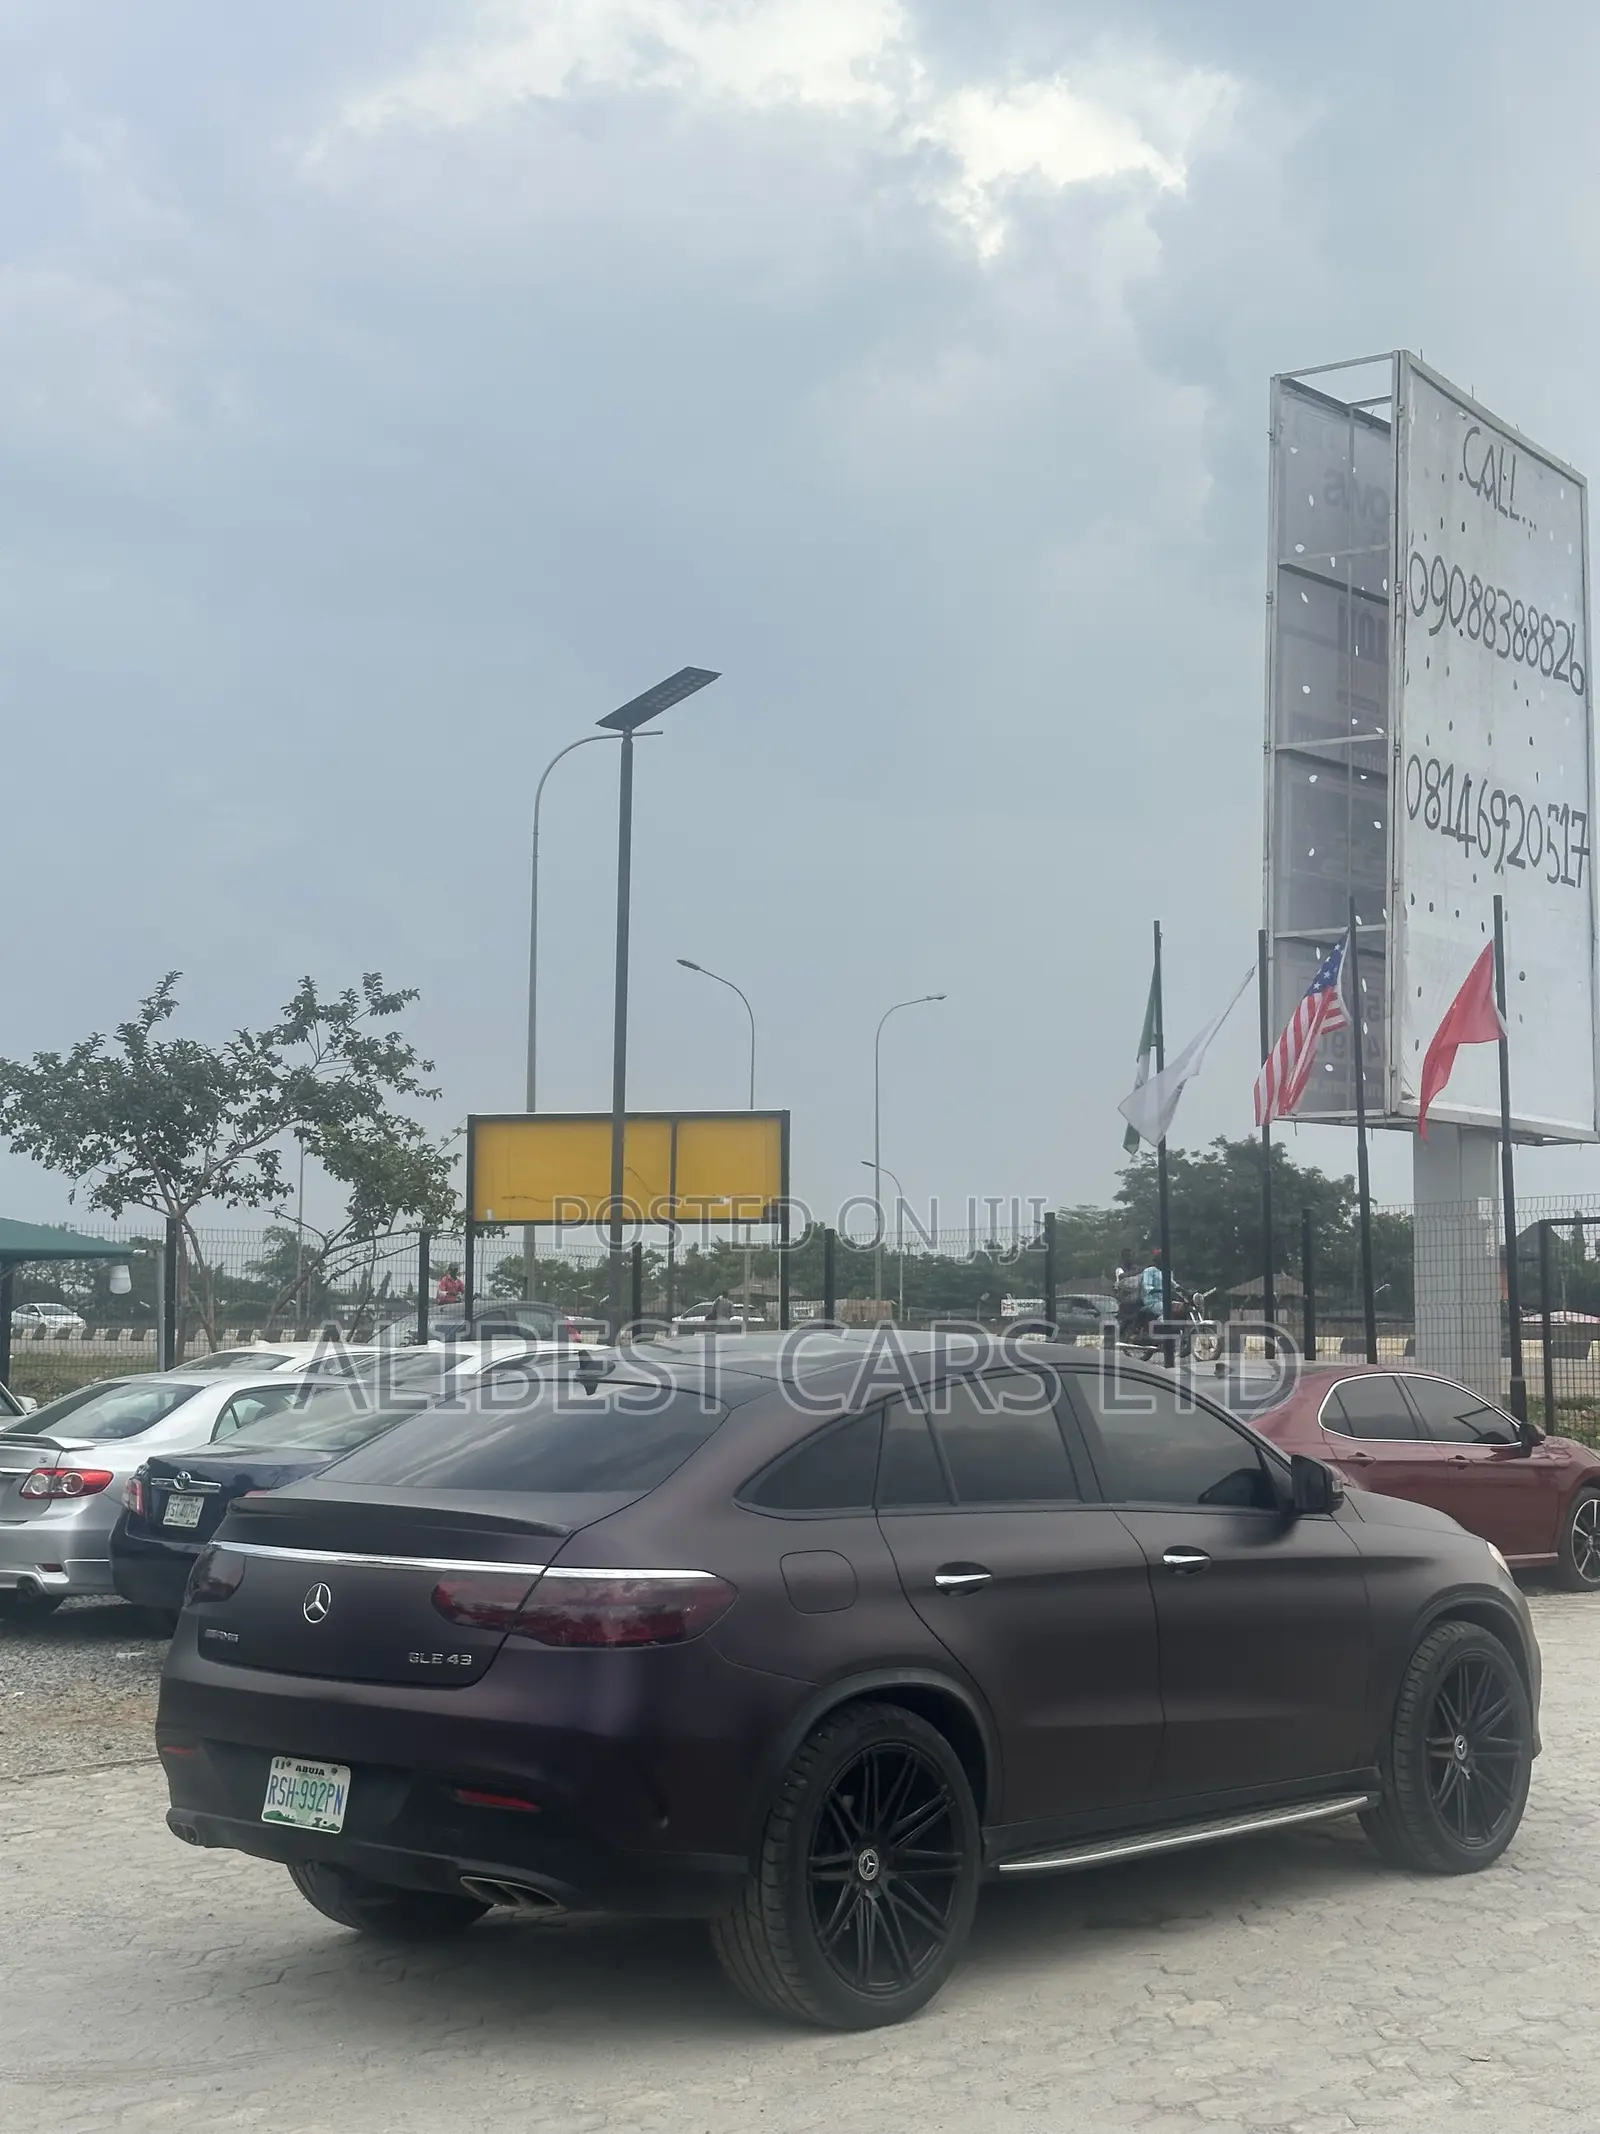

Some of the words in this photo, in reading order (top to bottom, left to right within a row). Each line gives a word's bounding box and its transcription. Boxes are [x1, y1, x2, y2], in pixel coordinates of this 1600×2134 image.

[1409, 551, 1585, 696] 09088388826
[1405, 754, 1590, 889] 08146920517
[408, 1652, 443, 1664] GLE
[447, 1654, 472, 1666] 43
[295, 1765, 325, 1776] ABUJA
[267, 1774, 345, 1816] RSH-992PN
